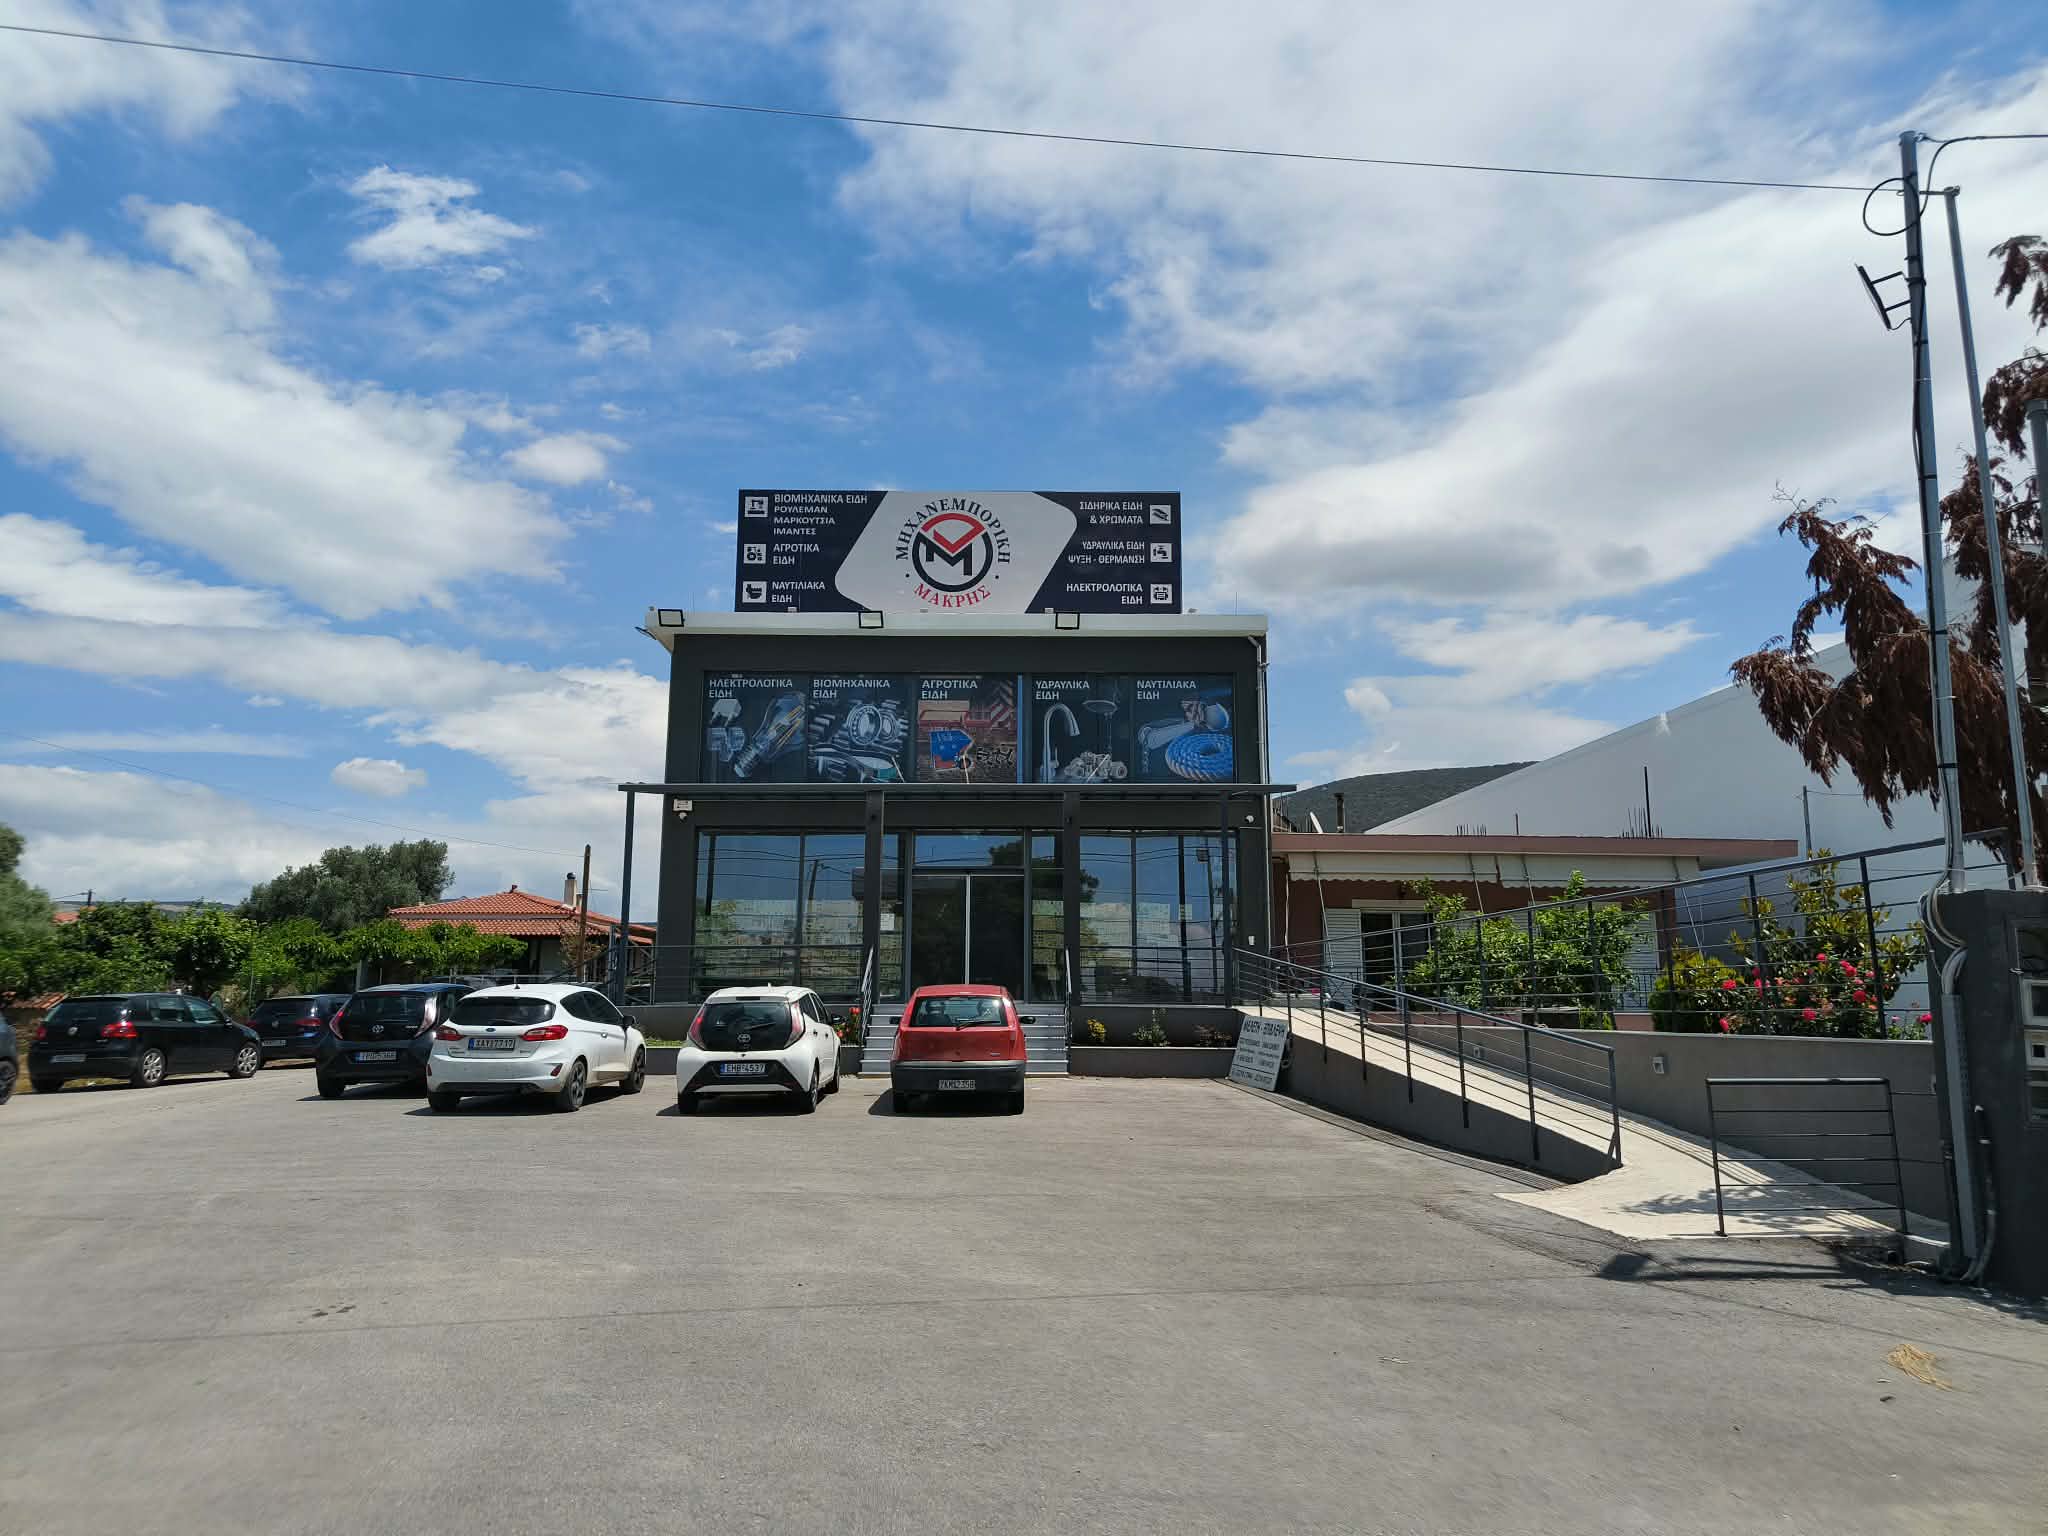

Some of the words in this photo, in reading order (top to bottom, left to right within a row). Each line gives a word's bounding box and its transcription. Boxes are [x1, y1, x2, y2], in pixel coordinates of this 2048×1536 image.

[774, 494, 844, 504] ΒΙΟΜΗΧΑΝΙΚΑ
[846, 495, 868, 504] ΕΙΔΗ
[774, 505, 828, 513] ΡΟΥΛΕΜΑΝ
[1079, 501, 1121, 510] ΣΙΔΗΡΙΚΑ
[1122, 501, 1143, 510] ΕΙΔΗ
[773, 517, 836, 525] ΜΑΡΚΟΥΤΣΙΑ
[1089, 515, 1098, 524] &
[1099, 515, 1144, 524] ΧΡΩΜΑΤΑ
[895, 497, 1011, 564] ΜΗΧΑΝΕΜΠΟΡΙΚΗ
[773, 543, 820, 553] ΑΓΡΟΤΙΚΑ
[1082, 541, 1125, 550] ΥΔΡΑΥΛΙΚΑ
[1126, 541, 1145, 550] ΕΙΔΗ
[773, 555, 795, 565] ΕΙΔΗ
[1068, 555, 1092, 564] ΨΥΞΗ
[1098, 555, 1145, 564] ΘΕΡΜΑΝΣΗ
[772, 581, 826, 590] ΝΑΥΤΙΛΙΑΚΑ
[1066, 583, 1143, 592] ΗΛΕΚΤΡΟΛΟΓΙΚΑ
[771, 594, 793, 603] ΕΙΔΗ
[914, 582, 991, 608] ΜΑΚΡΗΣ
[1121, 595, 1143, 605] ΕΙΔΗ
[709, 679, 793, 688] ΗΛΕΚΤΡΟΛΟΓΙΚΑ
[813, 679, 890, 688] ΒΙΟΜΗΧΑΝΙΚΑ
[922, 680, 978, 689] ΑΓΡΟΤΙΚΑ
[1035, 680, 1090, 689] ΥΔΡΑΥΛΙΚΑ
[1137, 680, 1196, 689] ΝΑΥΤΙΛΙΑΚΑ
[708, 689, 732, 698] ΕΙΔΗ
[813, 689, 837, 698] ΕΙΔΗ
[921, 690, 948, 699] ΕΙΔΗ
[1036, 691, 1060, 700] ΕΙΔΗ
[1137, 691, 1160, 700] ΕΙΔΗ
